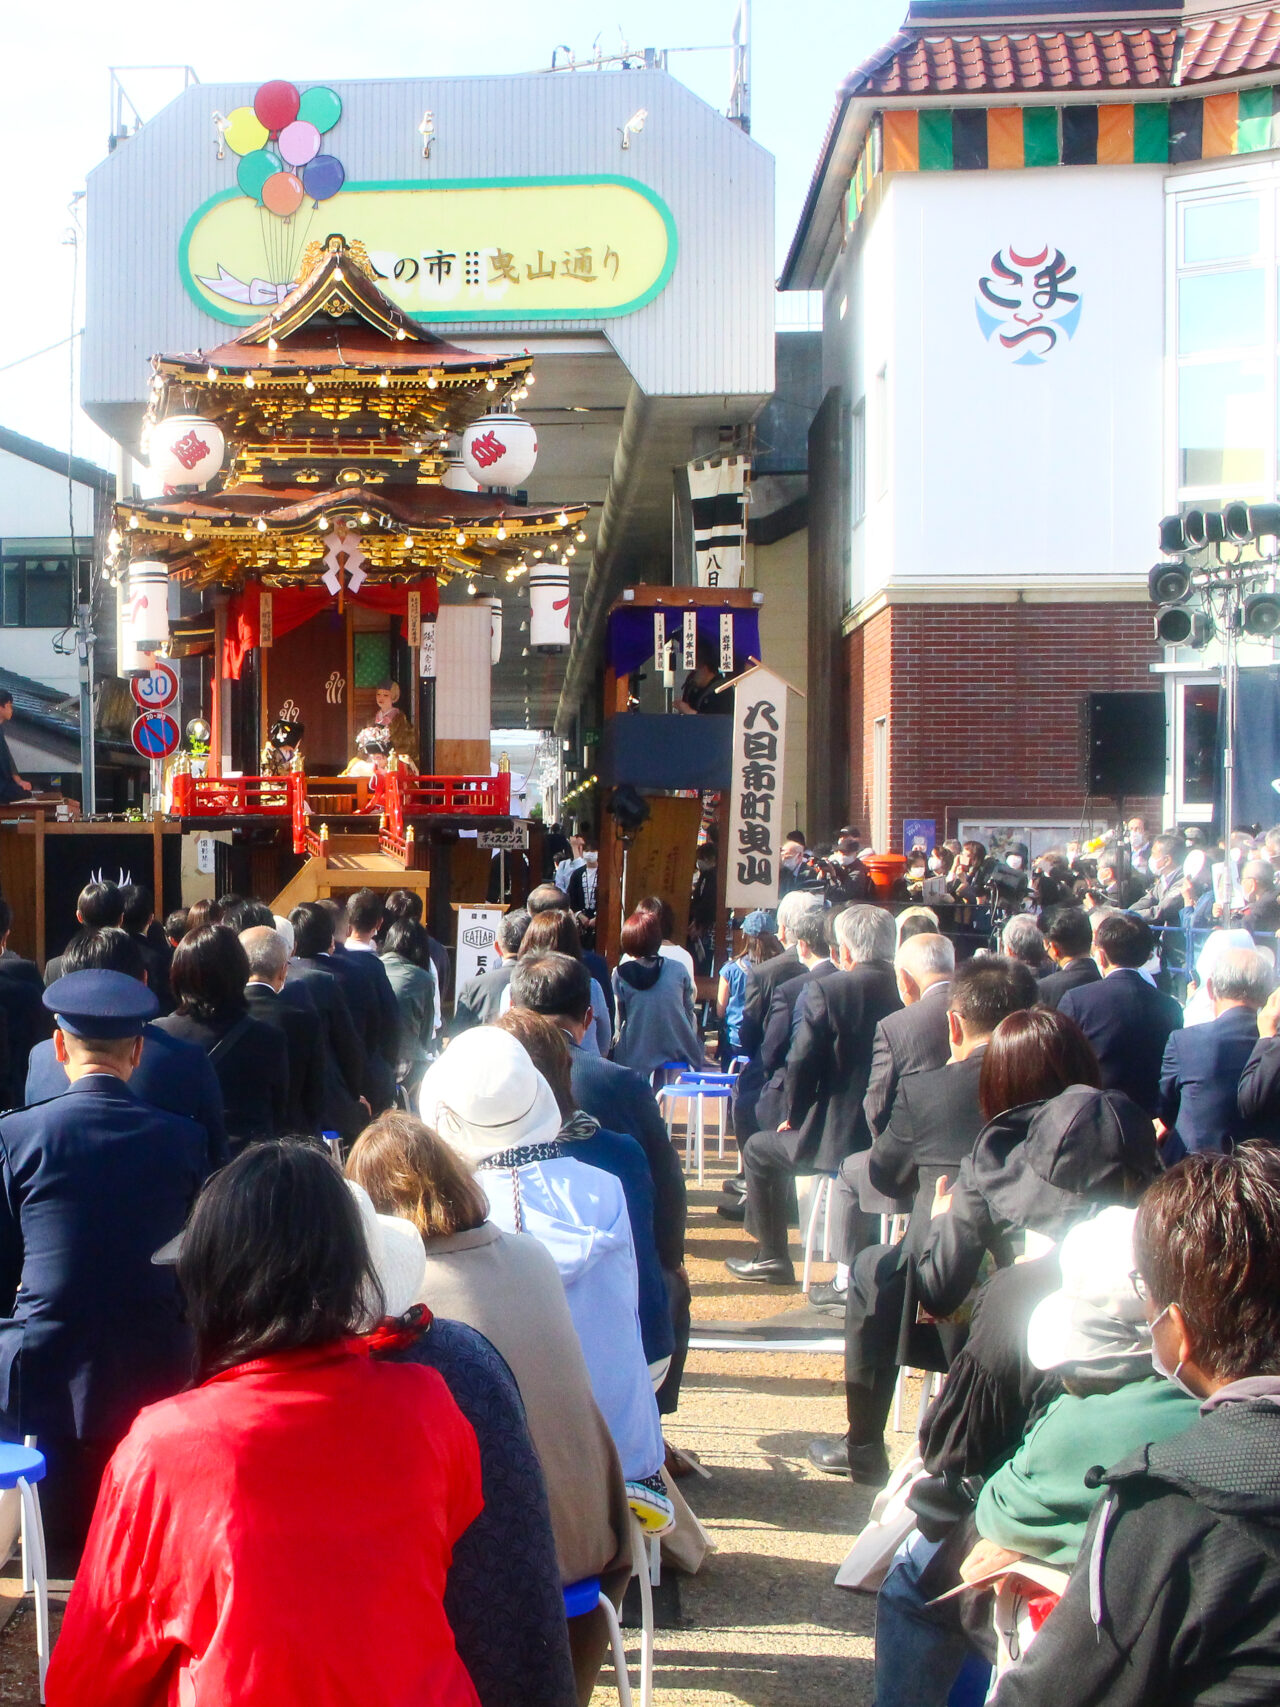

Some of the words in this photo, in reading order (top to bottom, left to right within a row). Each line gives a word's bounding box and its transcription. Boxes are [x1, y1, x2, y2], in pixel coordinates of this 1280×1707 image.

[487, 245, 620, 284] 曳山通り
[141, 675, 168, 696] 30
[736, 700, 780, 886] 八日市町曳山
[464, 929, 494, 947] EATLAB
